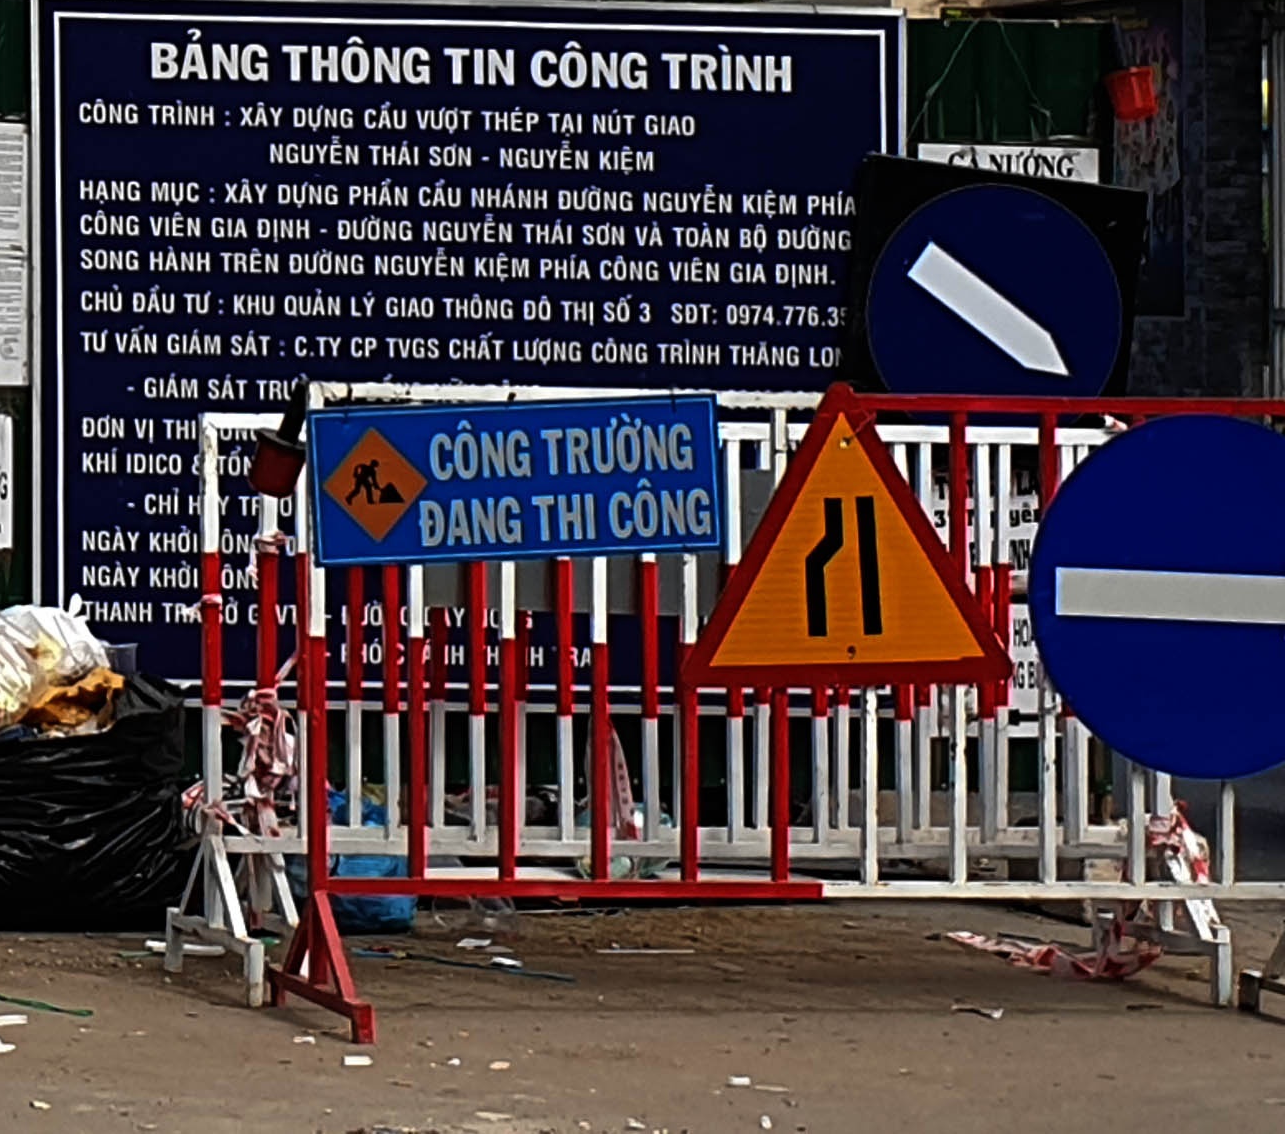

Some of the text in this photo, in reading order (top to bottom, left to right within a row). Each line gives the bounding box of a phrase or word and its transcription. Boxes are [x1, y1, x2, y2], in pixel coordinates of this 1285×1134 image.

[151, 28, 791, 92] BẢNG THÔNG TIN CÔNG TRÌNH
[79, 99, 694, 136] CÔNG TRÌNH XÂY DỰNG CẦU VƯỢT THÉP TẠI NÚT GIAO
[270, 136, 653, 174] NGUYỄN THÁI SƠN NGUYỄN KIỆM
[80, 178, 854, 218] HẠNG MỤC XÂY DỰNG PHẦN CẦU NHÁNH ĐƯỜNG NGUYỄN KIỆM PHÍA
[80, 210, 850, 252] CÔNG VIÊN GIA ĐỊNH ĐƯỜNG NGUYỄN THÁI SƠN VÀ TOÀN BỘ ĐƯỜNG
[81, 246, 835, 288] SONG HÀNH TRÊN ĐƯỜNG NGUYỄN KIỆM PHÍA CÔNG VIÊN GIA ĐỊNH.
[81, 285, 122, 312] CHỦ
[133, 285, 174, 313] ĐẦU
[184, 291, 211, 314] TƯ
[234, 295, 274, 315] KHU
[285, 289, 340, 316] QUẢN
[351, 292, 374, 316] LÝ
[386, 297, 433, 317] GIAO
[443, 294, 513, 319] THÔNG
[524, 296, 550, 320] ĐÔ
[561, 301, 593, 325] THỊ
[604, 295, 631, 322] SỐ
[640, 303, 650, 322] 3
[671, 303, 716, 324] SĐT:
[81, 330, 107, 352] TƯ
[115, 326, 157, 353] VẤN
[168, 330, 221, 354] GIÁM
[231, 331, 270, 356] SÁT
[295, 336, 341, 356] C.TY
[351, 337, 377, 357] CP
[386, 338, 439, 358] TVGS
[449, 332, 503, 360] CHẤT
[513, 338, 581, 364] LƯỢNG
[592, 338, 647, 363] CÔNG
[657, 340, 719, 364] TRÌNH
[729, 342, 799, 366] THĂNG
[144, 374, 198, 398] GIÁM
[208, 375, 247, 399] SÁT
[82, 415, 124, 438] ĐƠN
[135, 419, 153, 442] VỊ
[163, 419, 196, 439] THI
[430, 413, 693, 480] CÔNG TRƯỜNG
[83, 448, 116, 473] KHÍ
[127, 454, 181, 474] IDICO
[145, 488, 178, 514] CHỈ
[419, 478, 711, 547] ĐANG THI CÔNG
[83, 526, 139, 551] NGÀY
[150, 526, 197, 553] KHỞI
[83, 562, 139, 587] NGÀY
[150, 561, 198, 588] KHỞI
[84, 601, 153, 623] THANH
